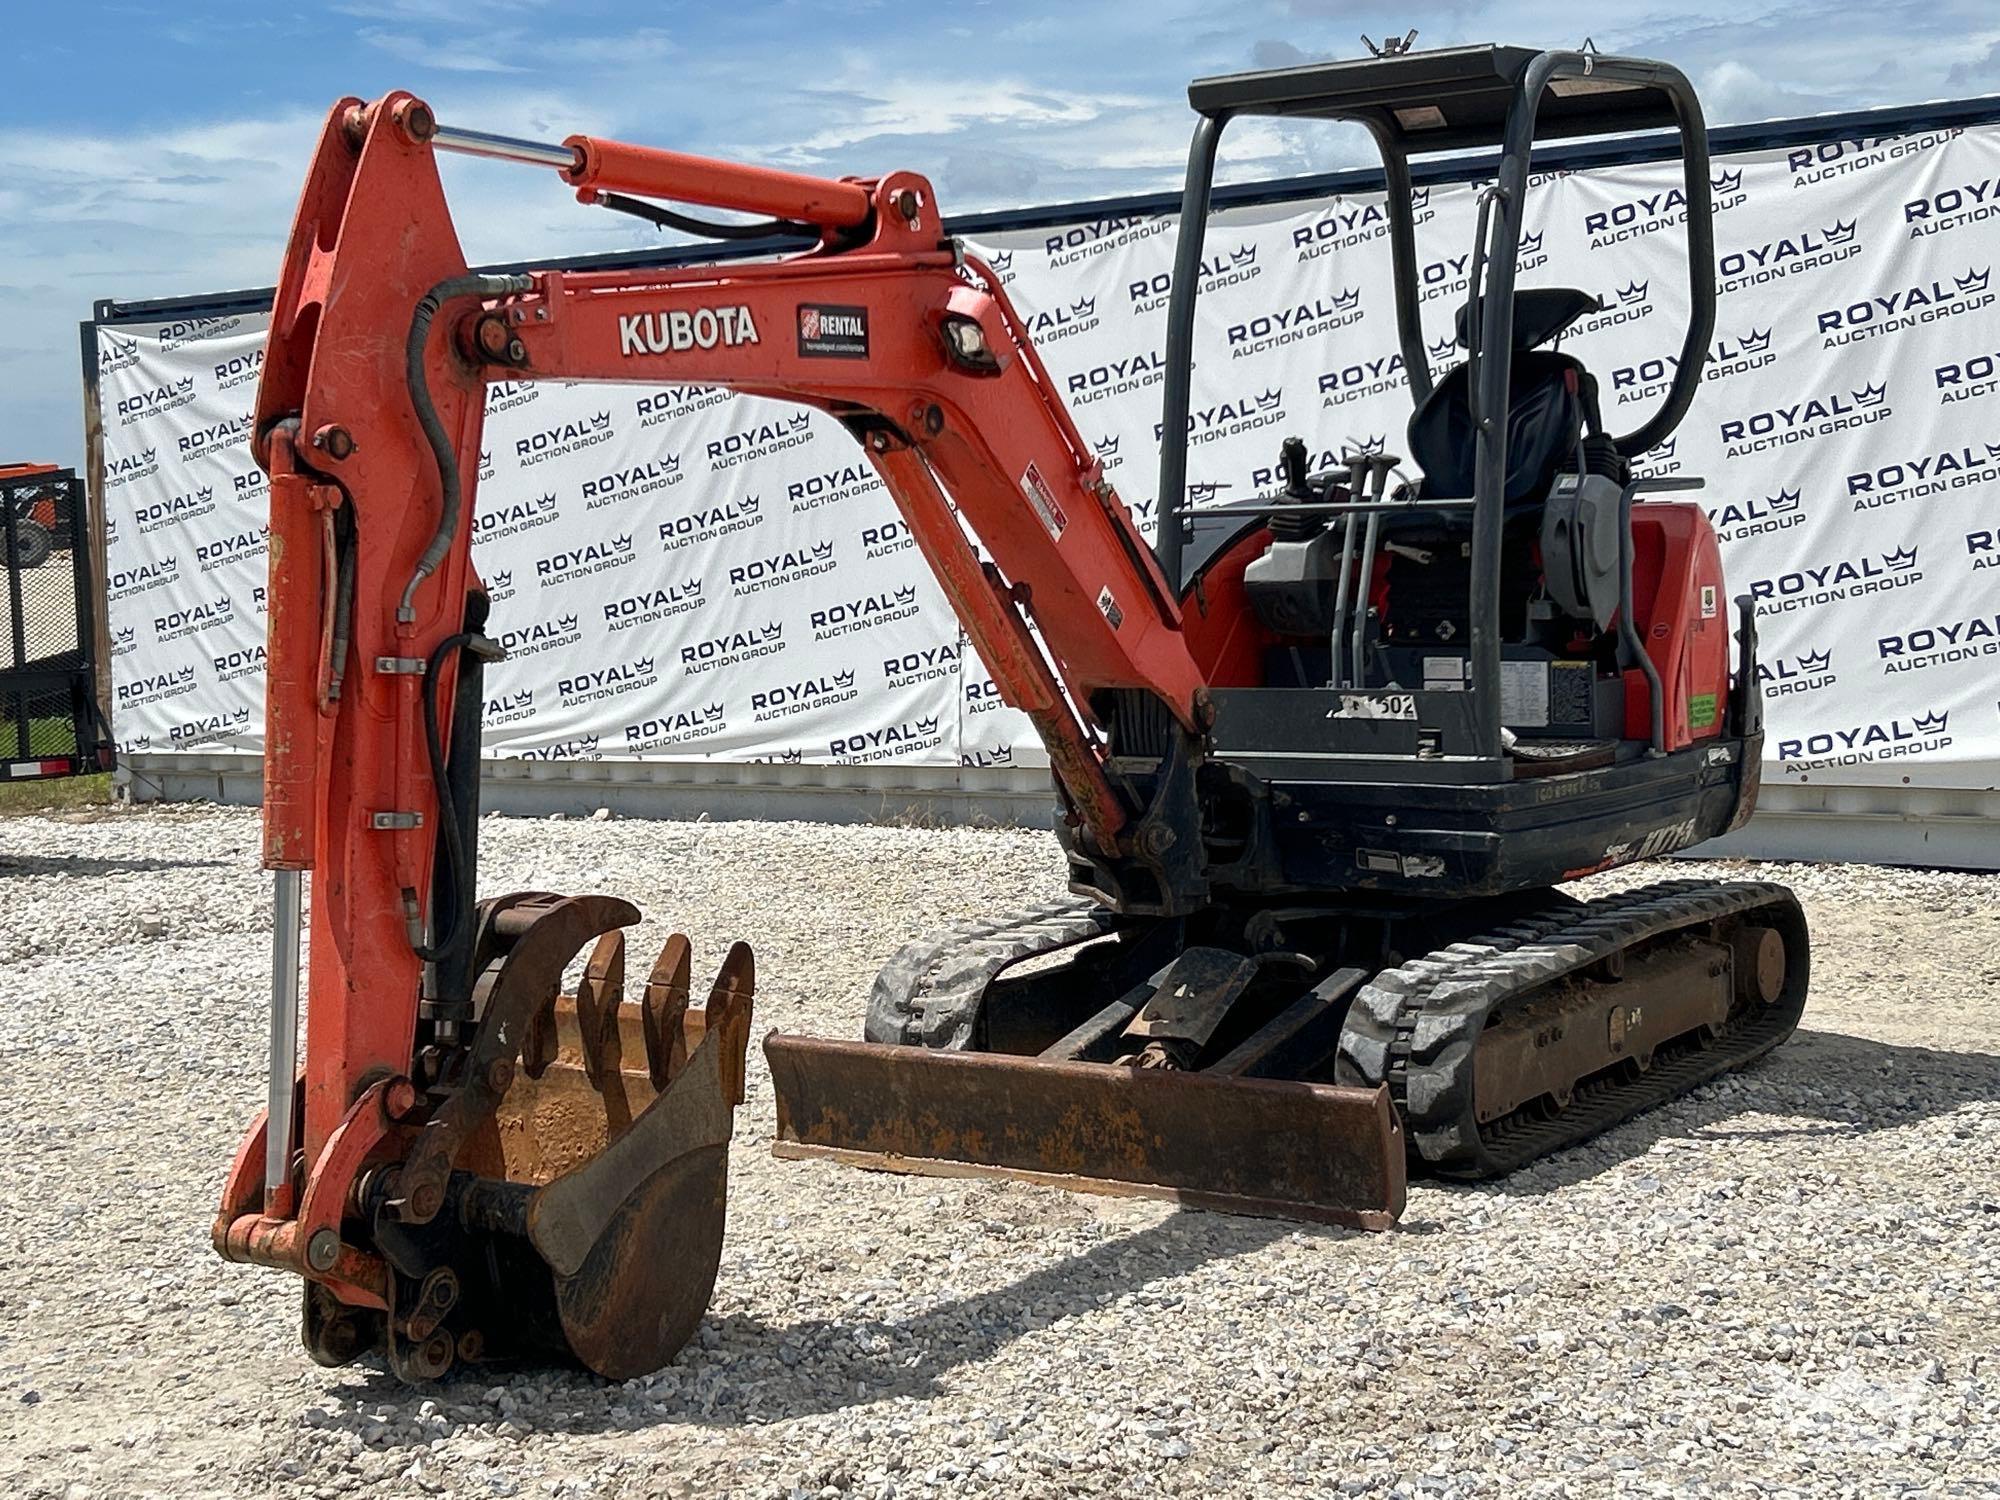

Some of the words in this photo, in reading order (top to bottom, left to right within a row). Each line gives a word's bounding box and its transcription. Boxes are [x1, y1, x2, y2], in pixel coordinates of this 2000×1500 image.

[1794, 152, 1885, 188] AUCTION
[1585, 189, 1688, 235] ROYA
[1905, 179, 2000, 223] ROY
[1293, 205, 1390, 247] ROYA
[1591, 216, 1674, 250] AUCTION
[1050, 241, 1115, 269] AUCTION
[1118, 221, 1171, 246] GROUP
[1298, 230, 1371, 262] AUCTION
[1720, 234, 1822, 276] OYAL
[1206, 267, 1261, 292] GROUP
[1716, 266, 1785, 296] UCTION
[1790, 245, 1861, 273] GROUP
[1228, 300, 1332, 345] ROYAL
[1587, 305, 1653, 332] GROUP
[1818, 282, 1954, 334] ROYAL
[1823, 315, 1915, 350] AUCTION
[1920, 294, 1995, 323] GROUP
[207, 319, 240, 338] GROUP
[619, 306, 759, 355] KUBOTA
[820, 314, 864, 336] RENTAL
[1047, 318, 1099, 342] GROUP
[1232, 329, 1303, 359] AUCTION
[1307, 311, 1364, 336] GROUP
[215, 350, 264, 380] ROYA
[1068, 352, 1166, 392] ROYAL
[1318, 353, 1404, 393] ROYA
[1707, 354, 1776, 380] GROUP
[118, 384, 177, 415] ROYAL
[500, 391, 539, 411] GROUP
[1073, 379, 1139, 407] AUCTION
[1323, 378, 1397, 408] AUCTION
[1941, 381, 2000, 405] AUCT
[121, 405, 161, 426] AUCTION
[164, 393, 196, 411] GROUP
[641, 404, 694, 428] AUCTION
[1230, 411, 1286, 435] GROUP
[1721, 395, 1852, 443] ROYAL
[178, 420, 241, 452] ROYAL
[516, 420, 591, 456] ROYAL
[520, 444, 570, 468] AUCTION
[573, 431, 613, 450] GROUP
[707, 422, 789, 459] ROYAL
[1727, 428, 1814, 459] AUCTION
[1819, 408, 1892, 435] GROUP
[183, 442, 223, 463] AUCTION
[711, 447, 766, 471] AUCTION
[769, 432, 813, 453] GROUP
[128, 464, 159, 481] GROUP
[582, 463, 660, 498] ROYAL
[788, 464, 873, 501] ROYAL
[1847, 448, 1985, 495] ROYAL
[586, 487, 639, 510] AUCTION
[642, 473, 684, 493] GROUP
[793, 490, 849, 513] AUCTION
[1854, 480, 1946, 512] AUCTION
[1952, 467, 2000, 489] GRO
[136, 494, 197, 524] ROYAL
[139, 515, 180, 535] AUCTION
[181, 503, 215, 521] GROUP
[520, 512, 559, 531] GROUP
[659, 504, 739, 540] ROYAL
[663, 529, 717, 552] AUCTION
[720, 515, 763, 534] GROUP
[1736, 514, 1806, 539] GROUP
[196, 532, 260, 561] ROYAL
[201, 553, 242, 572] AUCTION
[537, 543, 613, 576] ROYAL
[867, 539, 916, 560] AUCTIO
[541, 567, 592, 588] AUCTION
[594, 553, 636, 572] GROUP
[730, 550, 812, 585] ROYAL
[734, 575, 789, 597] AUCTION
[793, 561, 837, 580] GROUP
[1750, 558, 1883, 601] ROYAL
[107, 583, 145, 601] UCTION
[147, 574, 179, 589] GROUP
[604, 587, 682, 620] ROYAL
[1756, 588, 1845, 617] AUCTION
[1850, 572, 1923, 597] GROUP
[155, 604, 215, 632] ROYAL
[608, 610, 661, 632] AUCTION
[664, 598, 706, 617] GROUP
[810, 593, 895, 629] ROYAL
[815, 619, 872, 642] AUCTION
[875, 605, 919, 626] GROUP
[158, 625, 198, 643] AUCTION
[201, 614, 234, 630] GROUP
[502, 622, 559, 649] OYAL
[542, 633, 581, 651] GROUP
[1878, 615, 2000, 658] ROYA
[214, 646, 267, 672] ROYA
[681, 631, 761, 663] ROYAL
[685, 654, 739, 676] AUCTION
[742, 642, 785, 661] GROUP
[884, 642, 958, 676] ROYA
[1884, 646, 1977, 675] AUCTION
[118, 673, 179, 700] ROYAL
[219, 665, 261, 682] AUCTION
[558, 665, 635, 696] ROYAL
[888, 667, 949, 689] AUCTION
[1766, 675, 1836, 698] GROUP
[122, 692, 162, 710] AUCTION
[164, 683, 197, 698] GROUP
[562, 688, 614, 708] AUCTION
[616, 676, 658, 693] GROUP
[752, 678, 833, 710] ROYAL
[755, 701, 810, 723] AUCTION
[813, 690, 858, 708] GROUP
[170, 714, 231, 741] ROYAL
[497, 708, 536, 727] GROUP
[625, 711, 704, 741] ROYAL
[175, 734, 216, 751] AUCTION
[629, 732, 680, 753] AUCTION
[684, 723, 726, 740] GROUP
[830, 723, 917, 756] ROYAL
[895, 737, 941, 755] GROUP
[1779, 721, 1913, 761] ROYAL
[1786, 751, 1873, 774] AUCTION
[1879, 737, 1952, 759] GROUP
